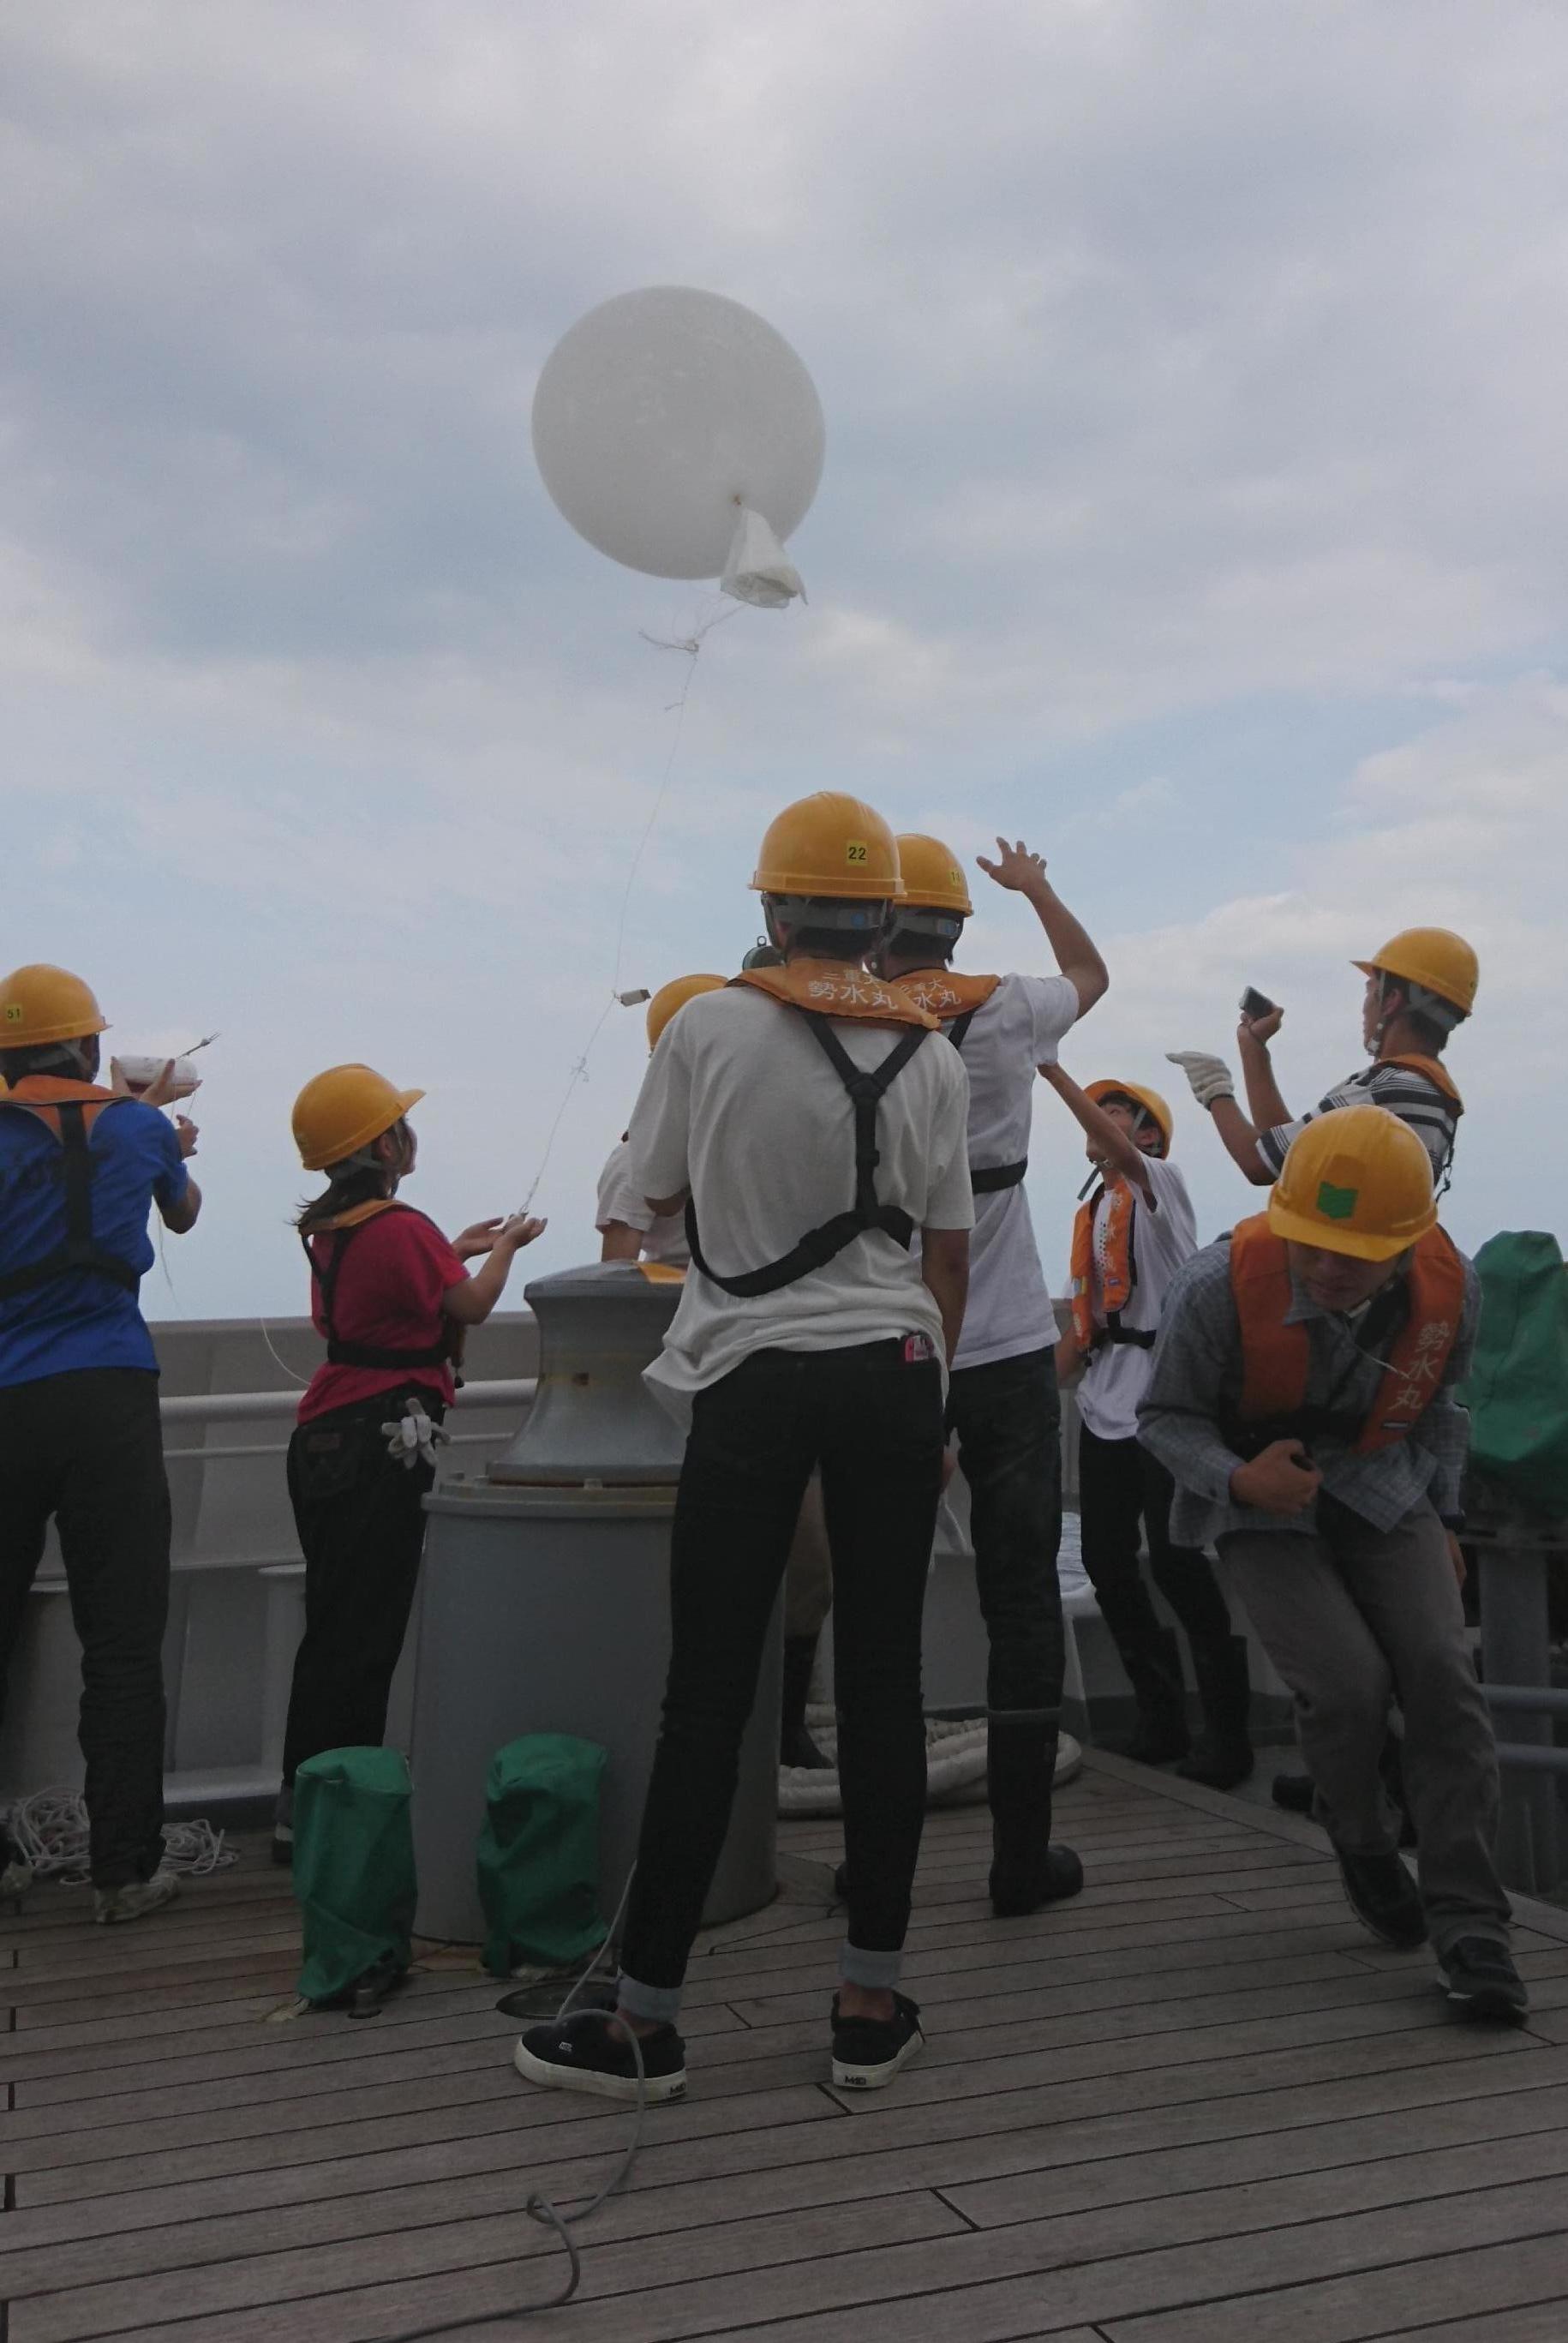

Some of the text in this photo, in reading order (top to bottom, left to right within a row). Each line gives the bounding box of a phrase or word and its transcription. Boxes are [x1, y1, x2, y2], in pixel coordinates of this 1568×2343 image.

[848, 846, 867, 860] 22
[1389, 1321, 1450, 1410] 勢水丸
